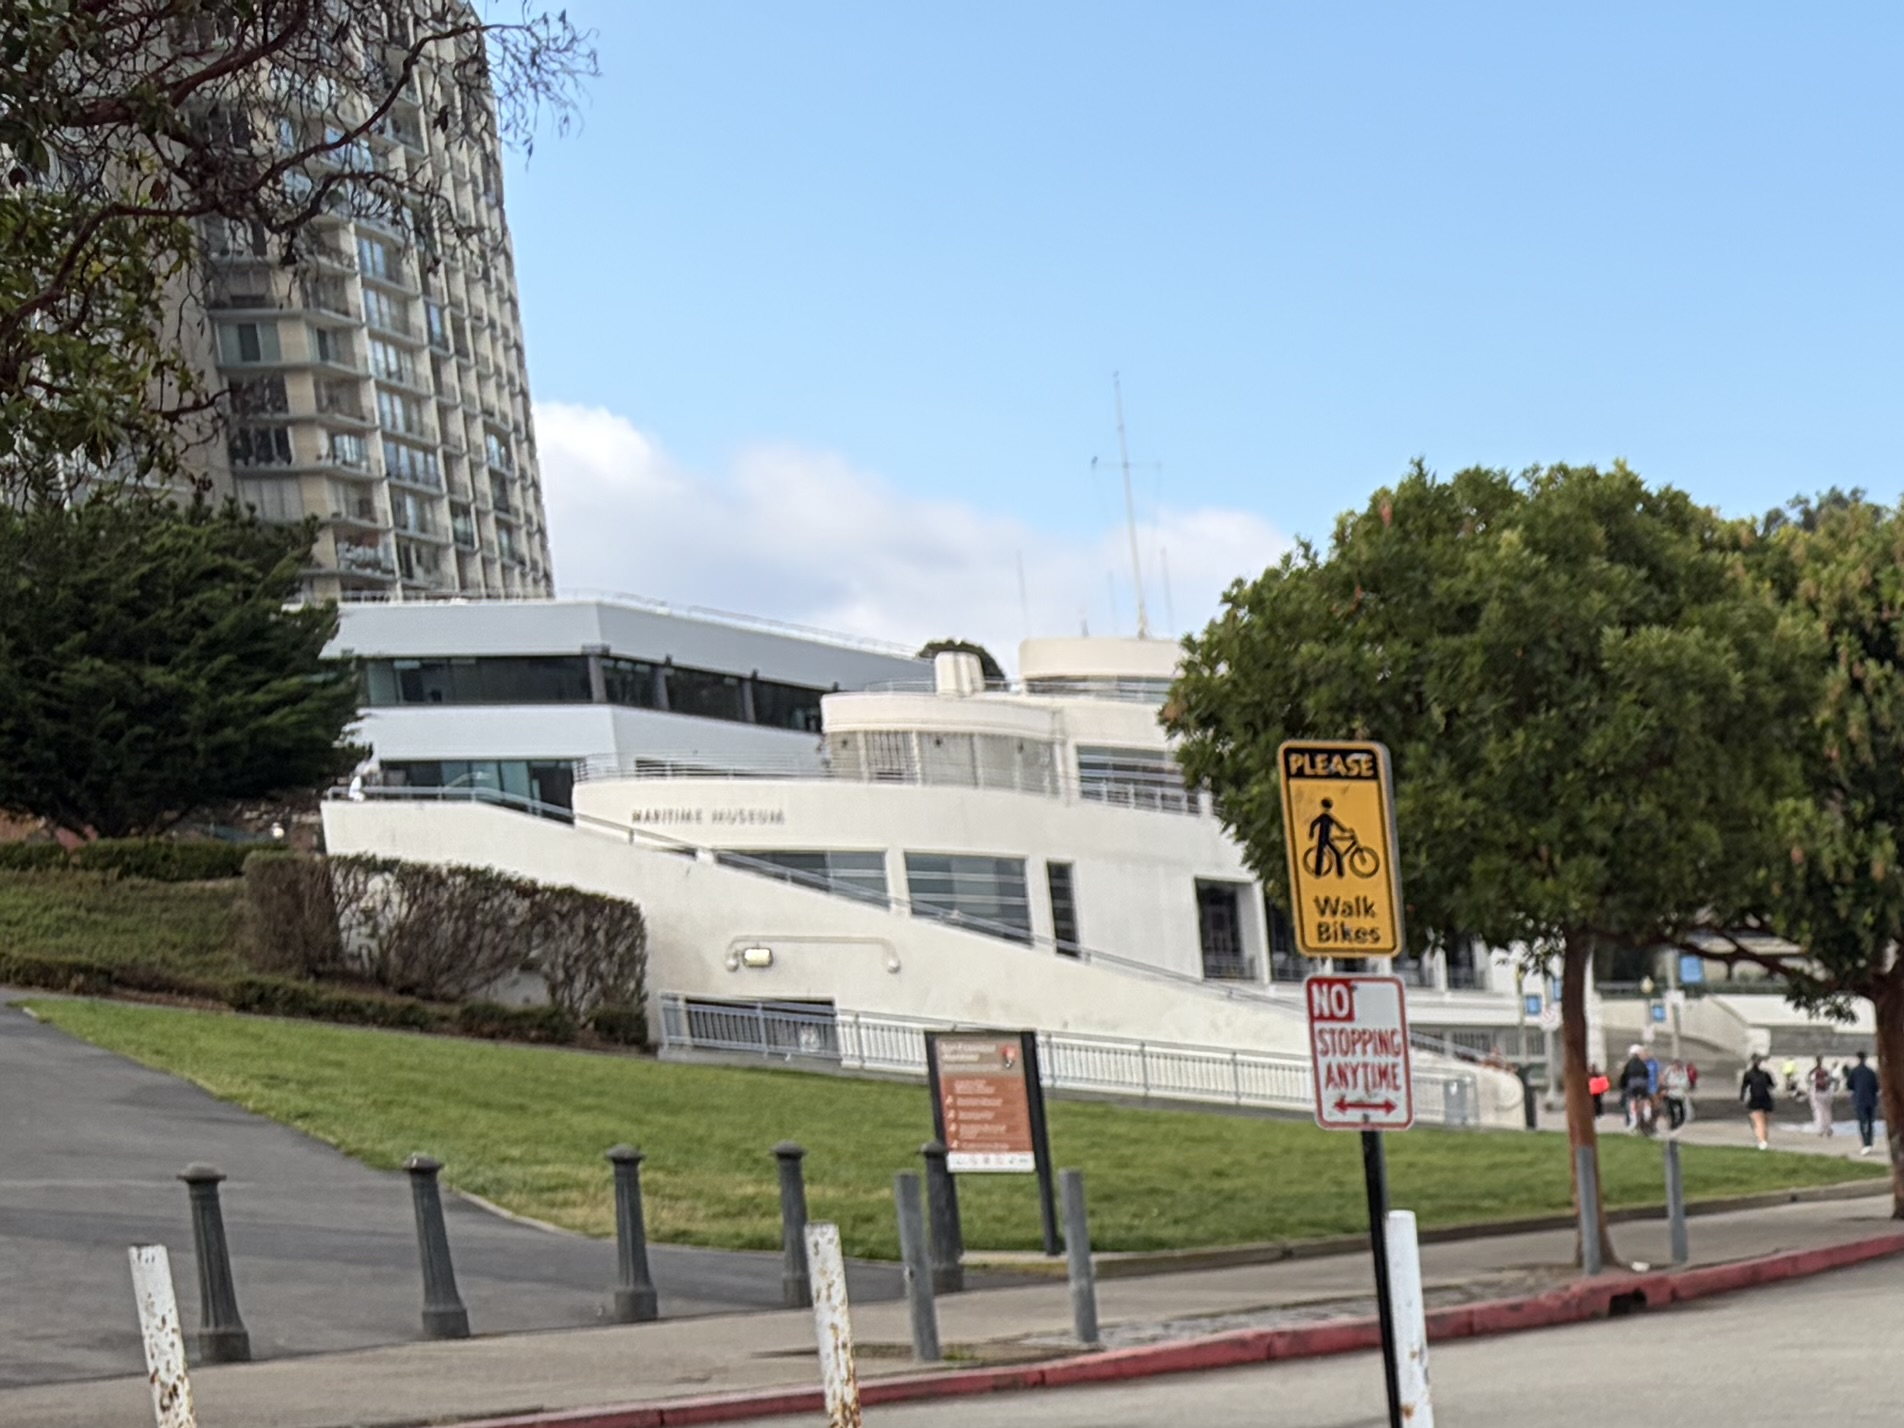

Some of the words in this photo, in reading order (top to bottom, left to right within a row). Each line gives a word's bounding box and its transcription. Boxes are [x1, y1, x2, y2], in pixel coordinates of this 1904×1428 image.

[1289, 753, 1375, 776] PLEASE
[632, 809, 702, 825] MARITIME
[712, 809, 785, 825] MUSEUM
[1313, 896, 1377, 919] Walk
[1316, 921, 1381, 945] Bikes
[1311, 982, 1350, 1018] NO
[1317, 1027, 1403, 1058] STOPPING
[1324, 1061, 1402, 1093] ANYTIME
